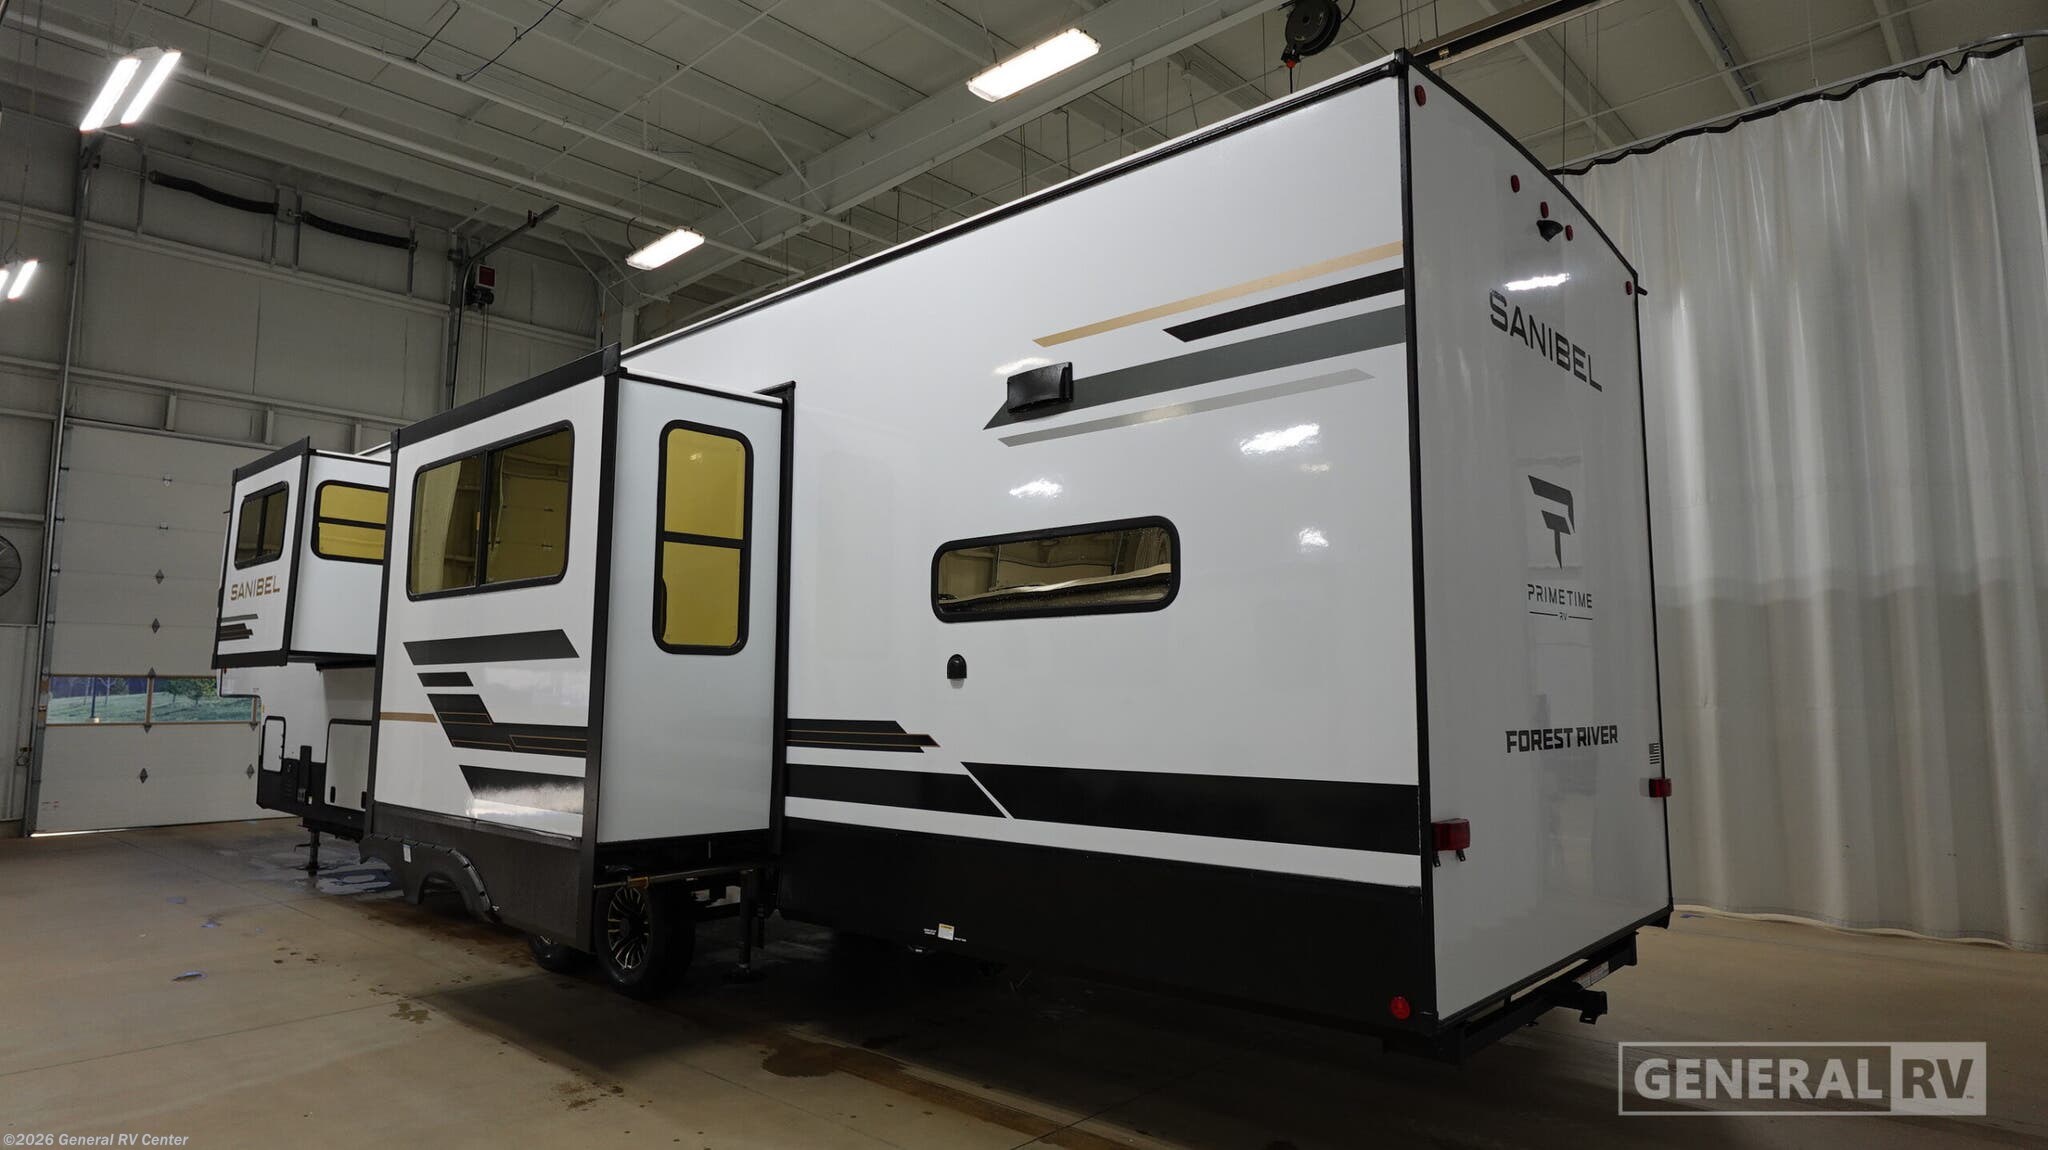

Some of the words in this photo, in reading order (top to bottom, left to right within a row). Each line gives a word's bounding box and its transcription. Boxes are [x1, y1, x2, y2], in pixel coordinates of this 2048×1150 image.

[1489, 288, 1603, 392] SANIBEL
[231, 576, 281, 601] SANIBEL
[1527, 584, 1593, 609] PRIMETIME
[1558, 612, 1568, 621] RV
[1505, 728, 1573, 753] FOREST
[1576, 725, 1618, 748] RIVER
